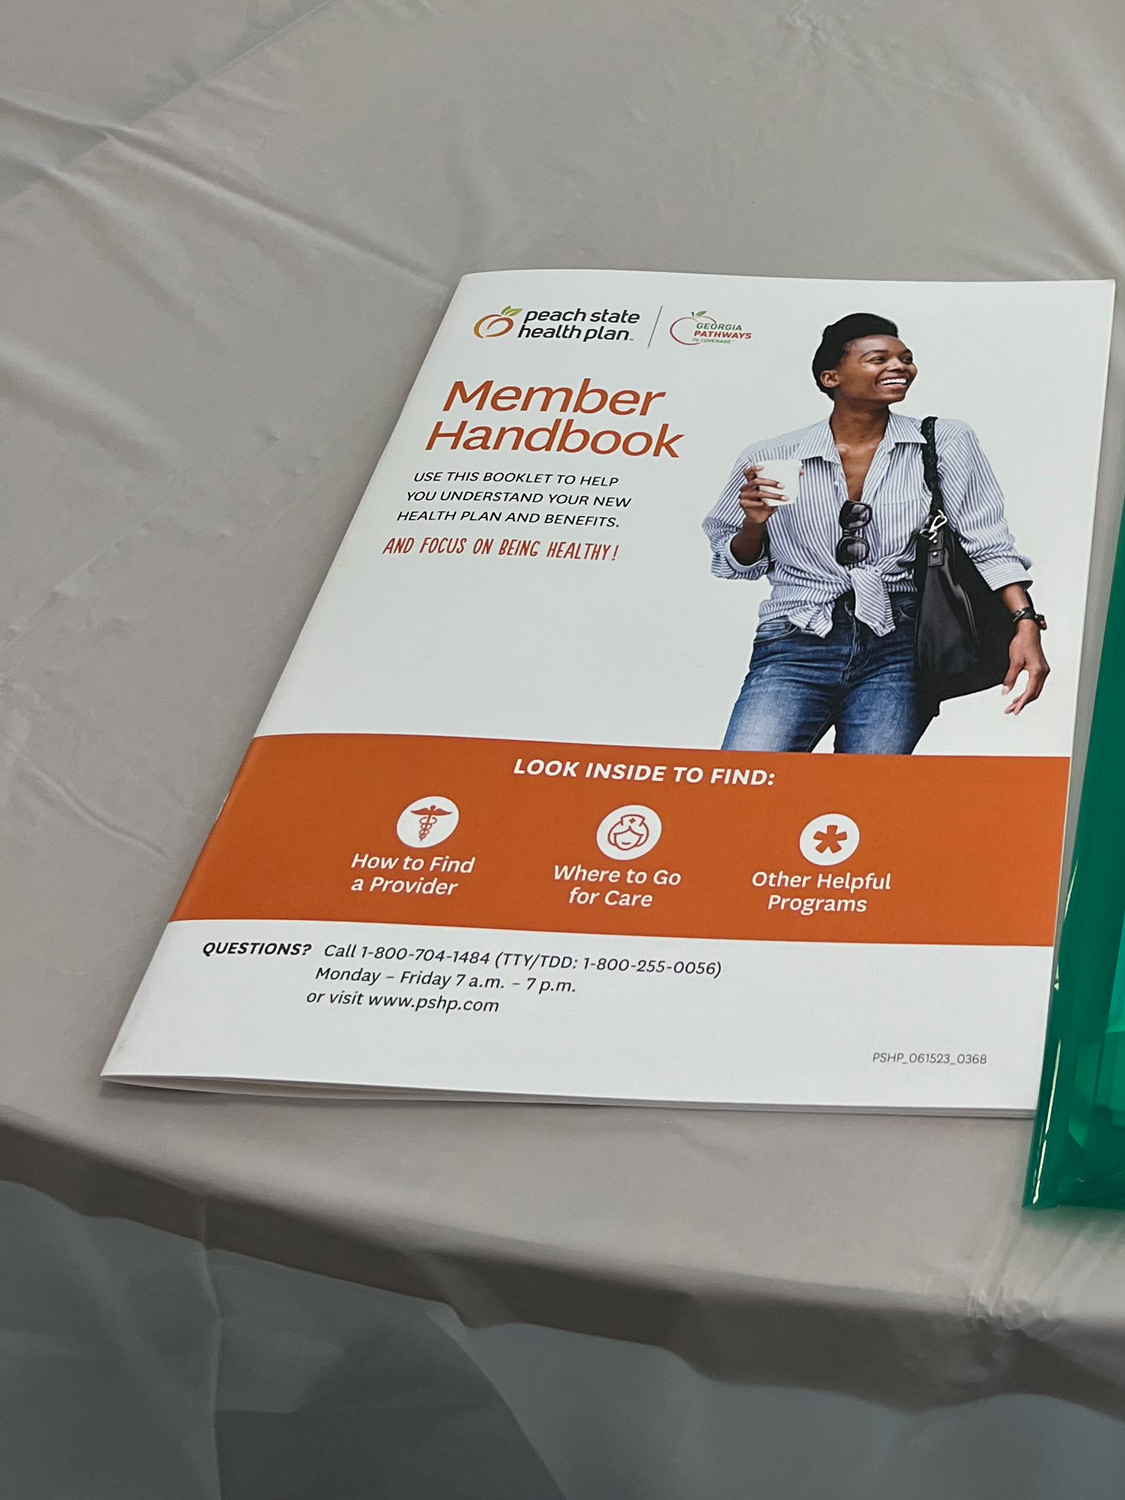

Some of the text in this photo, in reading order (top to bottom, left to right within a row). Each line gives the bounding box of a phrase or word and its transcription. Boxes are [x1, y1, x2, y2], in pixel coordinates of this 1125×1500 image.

[523, 307, 641, 324] peach state
[517, 323, 630, 342] health plan
[694, 330, 752, 340] PATHWAYS
[696, 322, 743, 332] GEORGIA
[443, 377, 667, 416] Member
[425, 418, 685, 458] Handbook
[413, 471, 619, 487] USE THIS BOOKLET TO HELP
[406, 490, 632, 508] YOU UNDERSTAND YOUR NEW
[396, 510, 620, 528] HEALTH PLAN AND BENEFITS.
[382, 537, 415, 555] AND
[419, 537, 467, 555] FOCUS
[472, 538, 494, 555] ON
[498, 538, 541, 557] BEING
[513, 758, 776, 786] LOOK INSIDE TO FIND:
[351, 852, 476, 874] How to Find
[553, 863, 682, 886] Where to Go
[751, 870, 892, 893] Other Helpful
[351, 876, 459, 896] a Provider
[568, 886, 653, 908] for Care
[766, 893, 868, 916] Programs
[202, 941, 722, 979] QUESTIONS? Call 1-800-704-1484 (TTY/TDD: 1-800-255-0056)
[315, 967, 382, 986] Monday
[399, 970, 452, 989] Friday
[456, 974, 466, 986] 7
[468, 975, 505, 988] a.m.
[526, 978, 537, 990] 7
[538, 979, 576, 995] p.m.
[306, 990, 500, 1014] or visit www.pshp.com
[872, 1052, 987, 1066] PSHP_061523_0368
